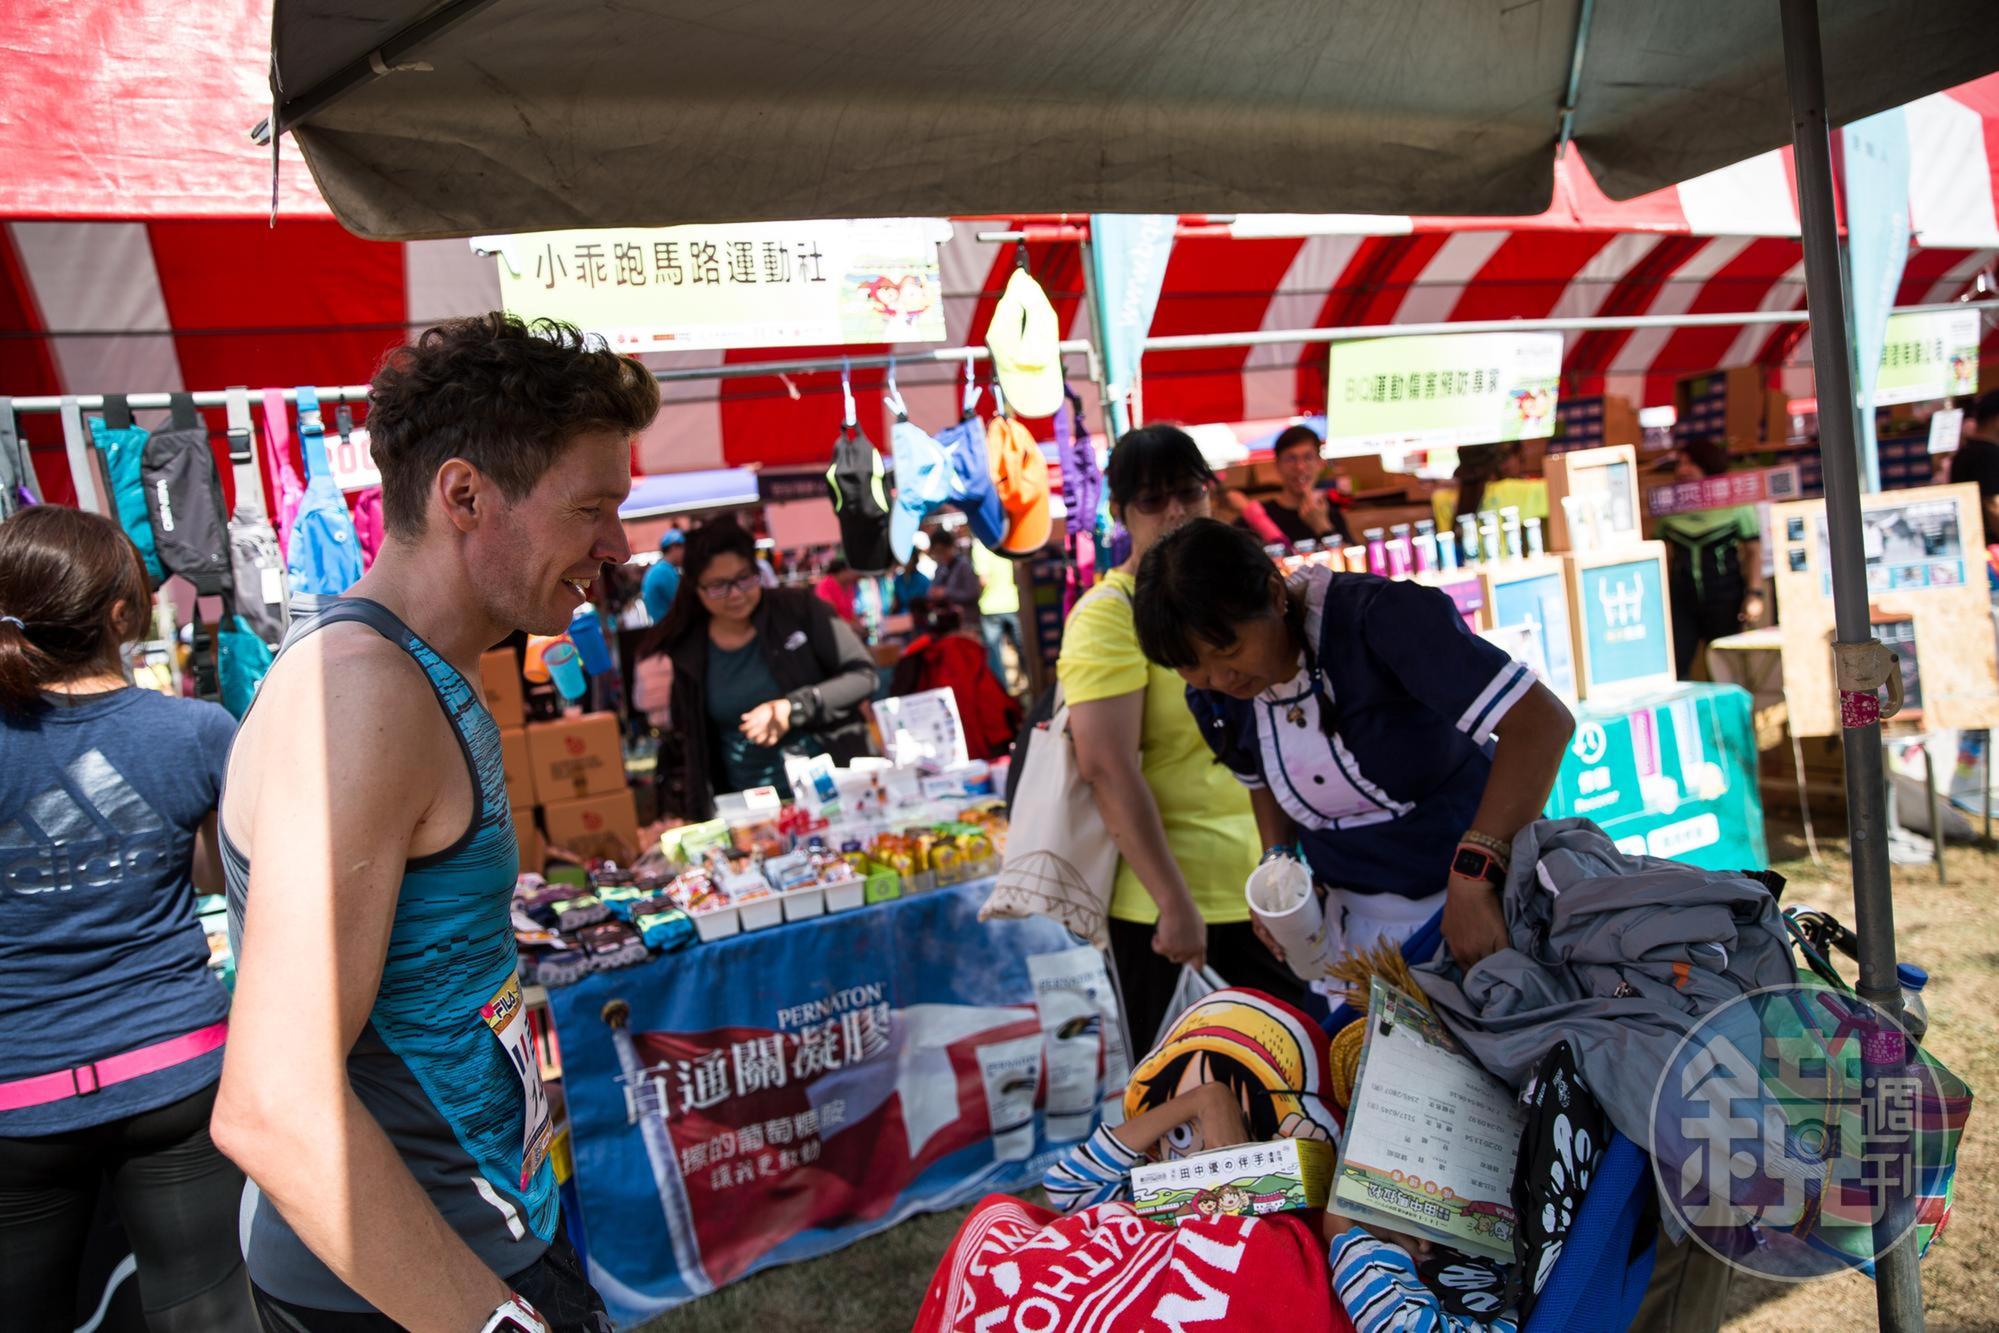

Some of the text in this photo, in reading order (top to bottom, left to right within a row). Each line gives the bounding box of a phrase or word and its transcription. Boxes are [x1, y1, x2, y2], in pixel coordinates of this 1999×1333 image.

[536, 241, 826, 289] 小乖跑馬路運動社
[493, 990, 516, 1020] FILA
[776, 982, 884, 1029] PERNATON
[615, 1001, 892, 1125] 百通關凝膠
[1368, 1183, 1438, 1216] 田中馬拉松
